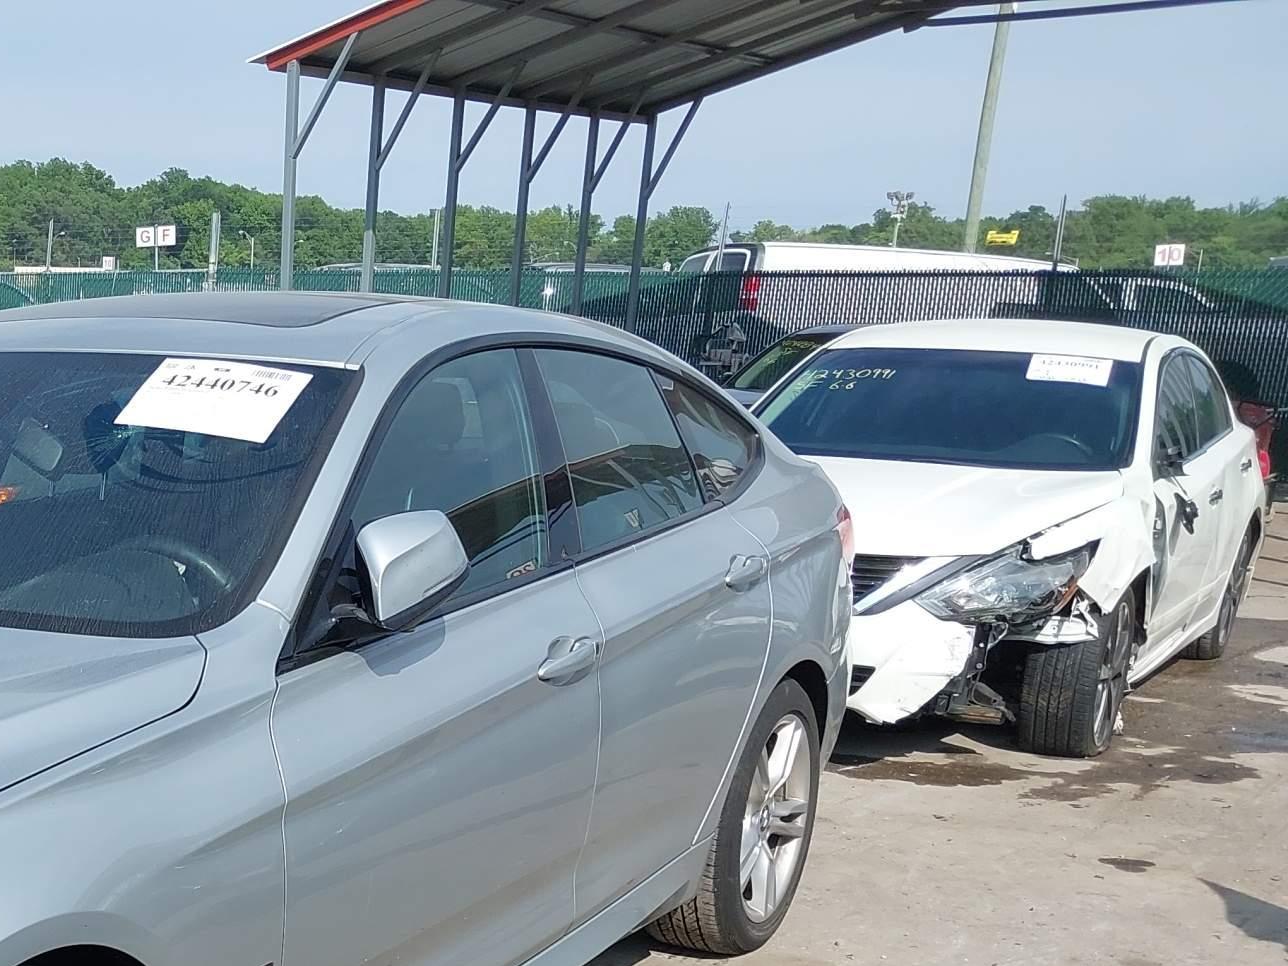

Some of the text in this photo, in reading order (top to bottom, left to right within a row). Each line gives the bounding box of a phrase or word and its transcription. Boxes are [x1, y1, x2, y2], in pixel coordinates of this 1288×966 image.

[140, 230, 151, 243] G
[162, 228, 171, 242] F
[162, 374, 279, 398] 42440746
